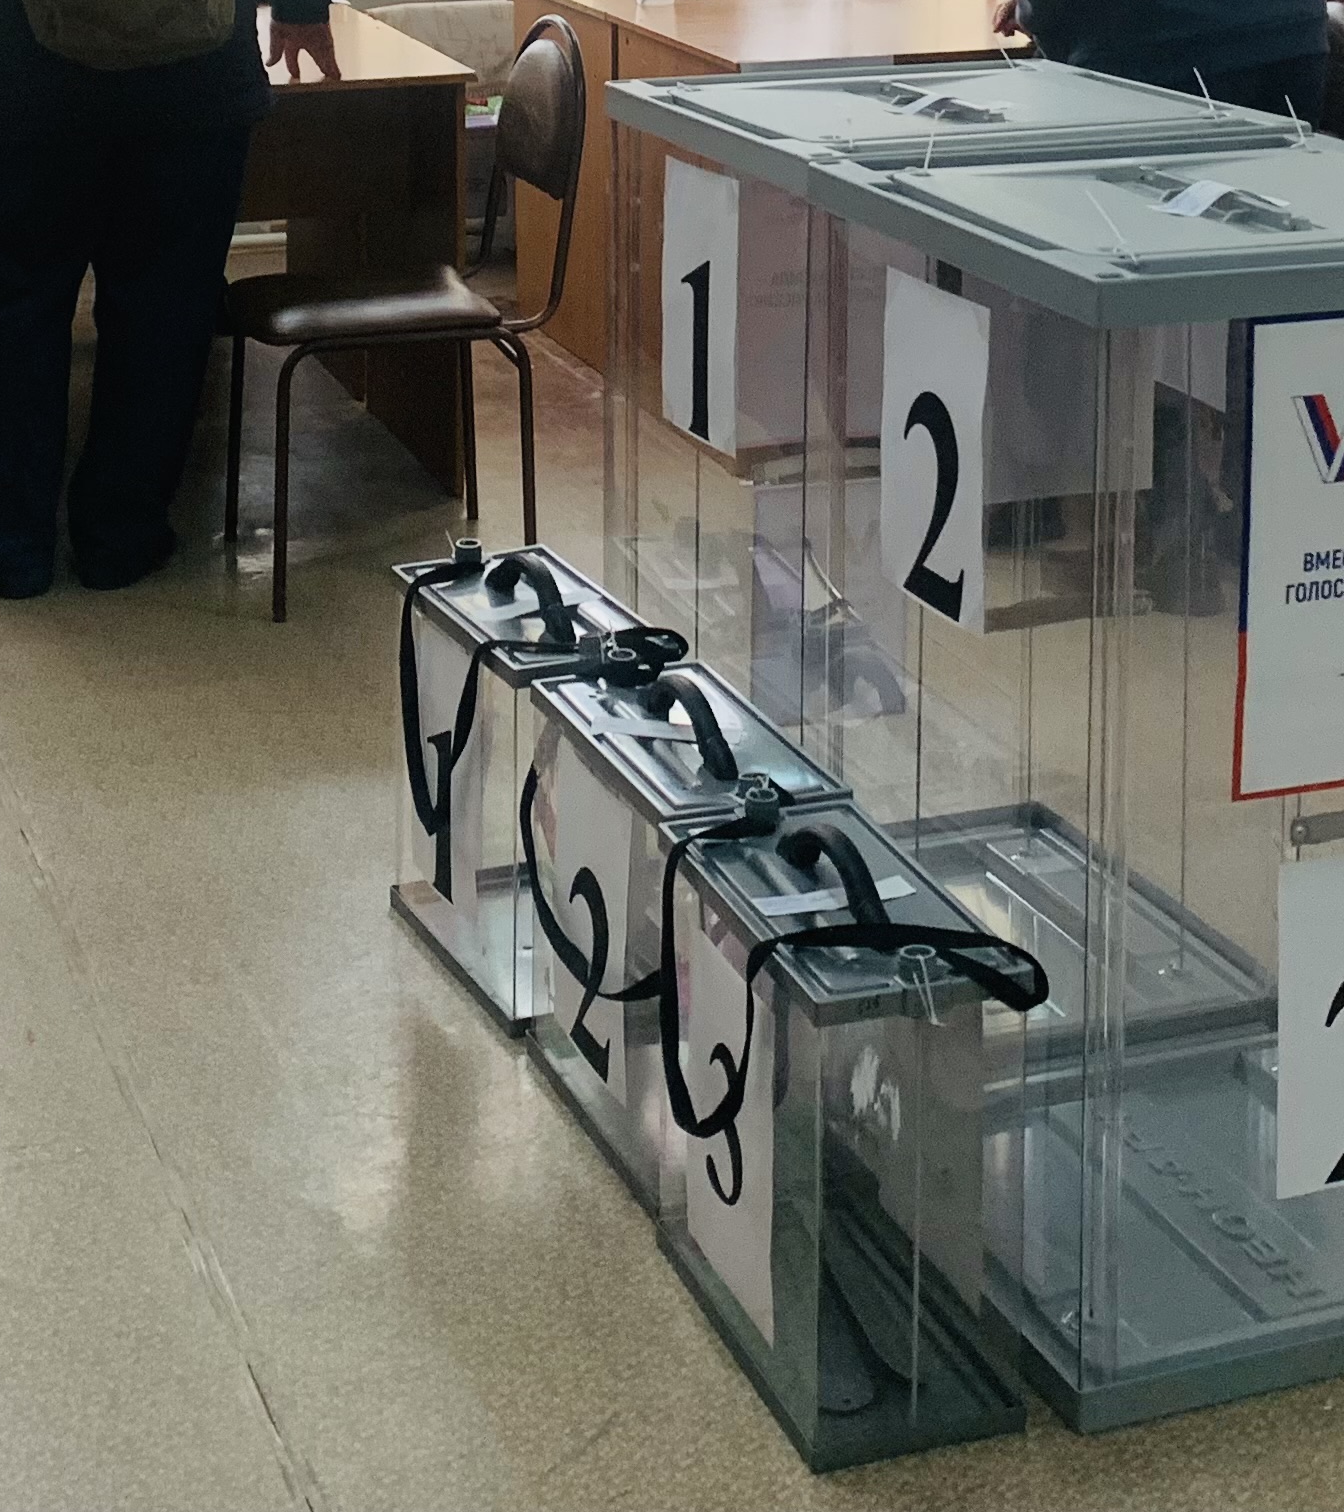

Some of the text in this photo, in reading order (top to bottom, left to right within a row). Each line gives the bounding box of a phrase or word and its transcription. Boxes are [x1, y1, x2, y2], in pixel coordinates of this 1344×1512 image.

[681, 260, 710, 442] 1
[903, 390, 964, 623] 2
[569, 866, 610, 1084] 2
